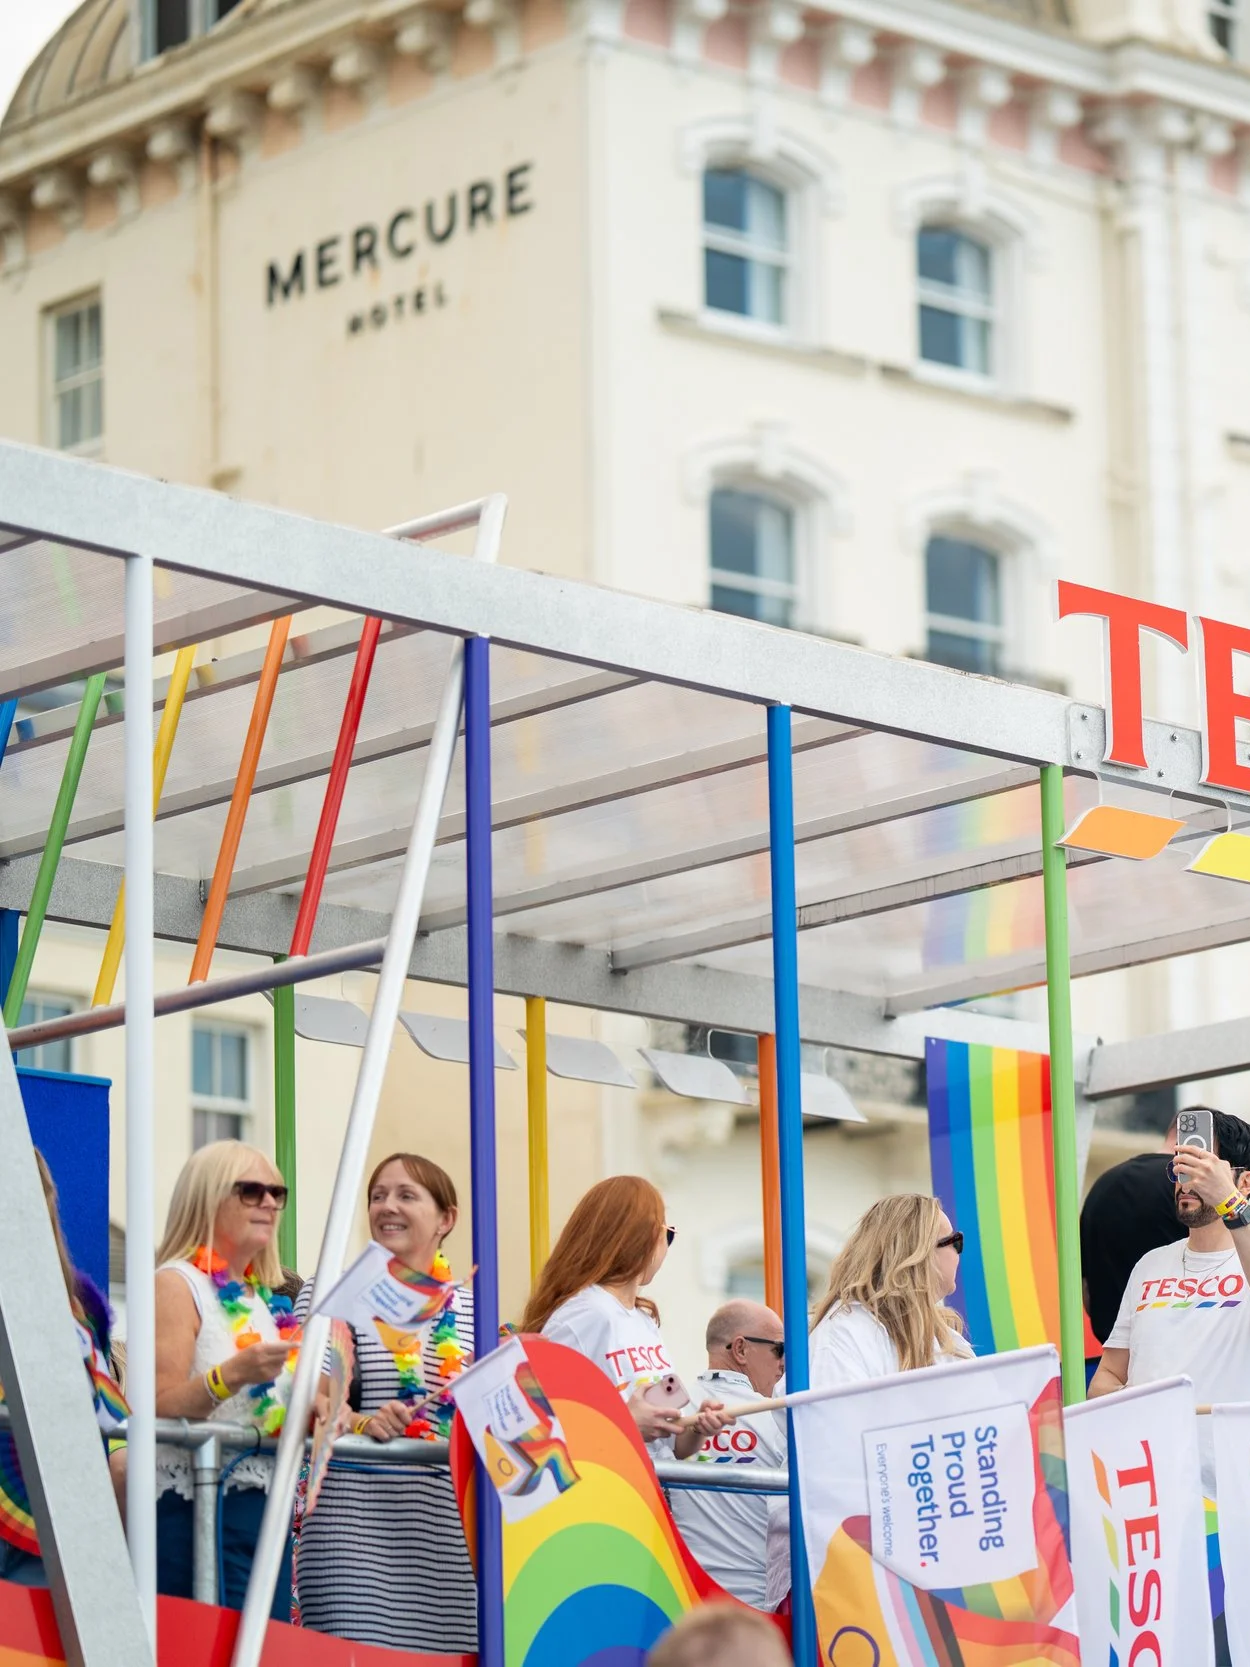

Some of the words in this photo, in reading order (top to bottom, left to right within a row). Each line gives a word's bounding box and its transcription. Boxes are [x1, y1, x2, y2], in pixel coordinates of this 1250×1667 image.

[265, 160, 534, 310] MERCURE
[347, 278, 446, 337] HOTEL
[1141, 1274, 1244, 1301] TESCO
[876, 1442, 893, 1504] Everyone's
[907, 1434, 942, 1568] Together.
[942, 1431, 974, 1519] Proud
[974, 1425, 1007, 1551] Standing
